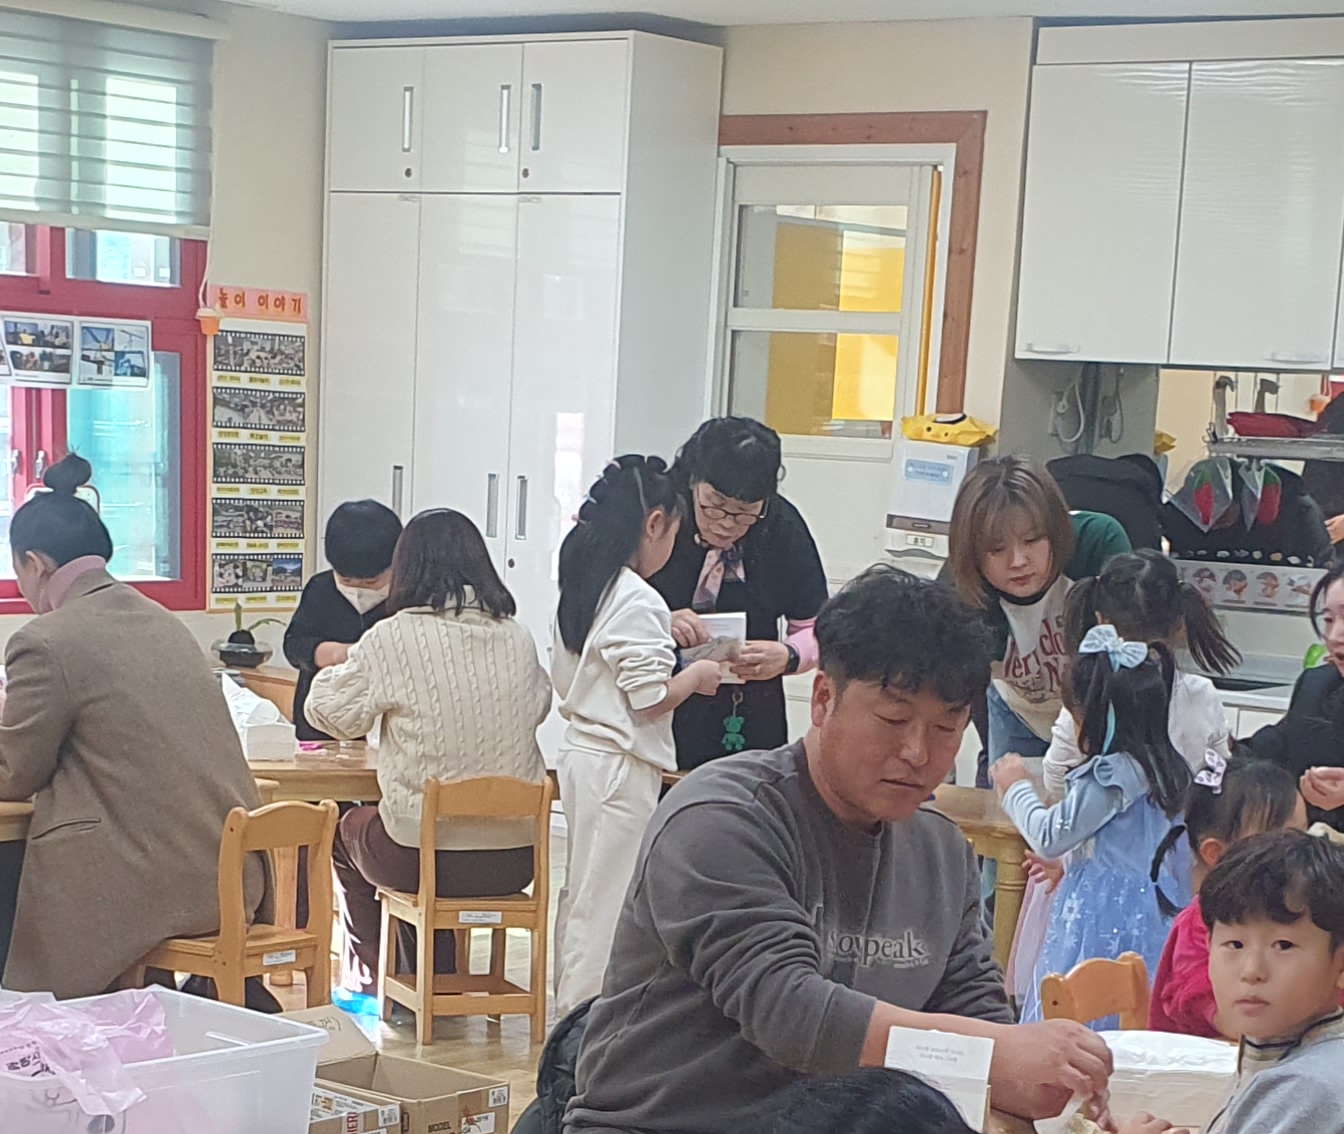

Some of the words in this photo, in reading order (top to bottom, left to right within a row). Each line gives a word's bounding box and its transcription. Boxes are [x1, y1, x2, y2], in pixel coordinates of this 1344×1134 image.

[219, 288, 245, 308] 놀이
[258, 293, 301, 314] 이야기
[428, 1121, 451, 1133] MODEL
